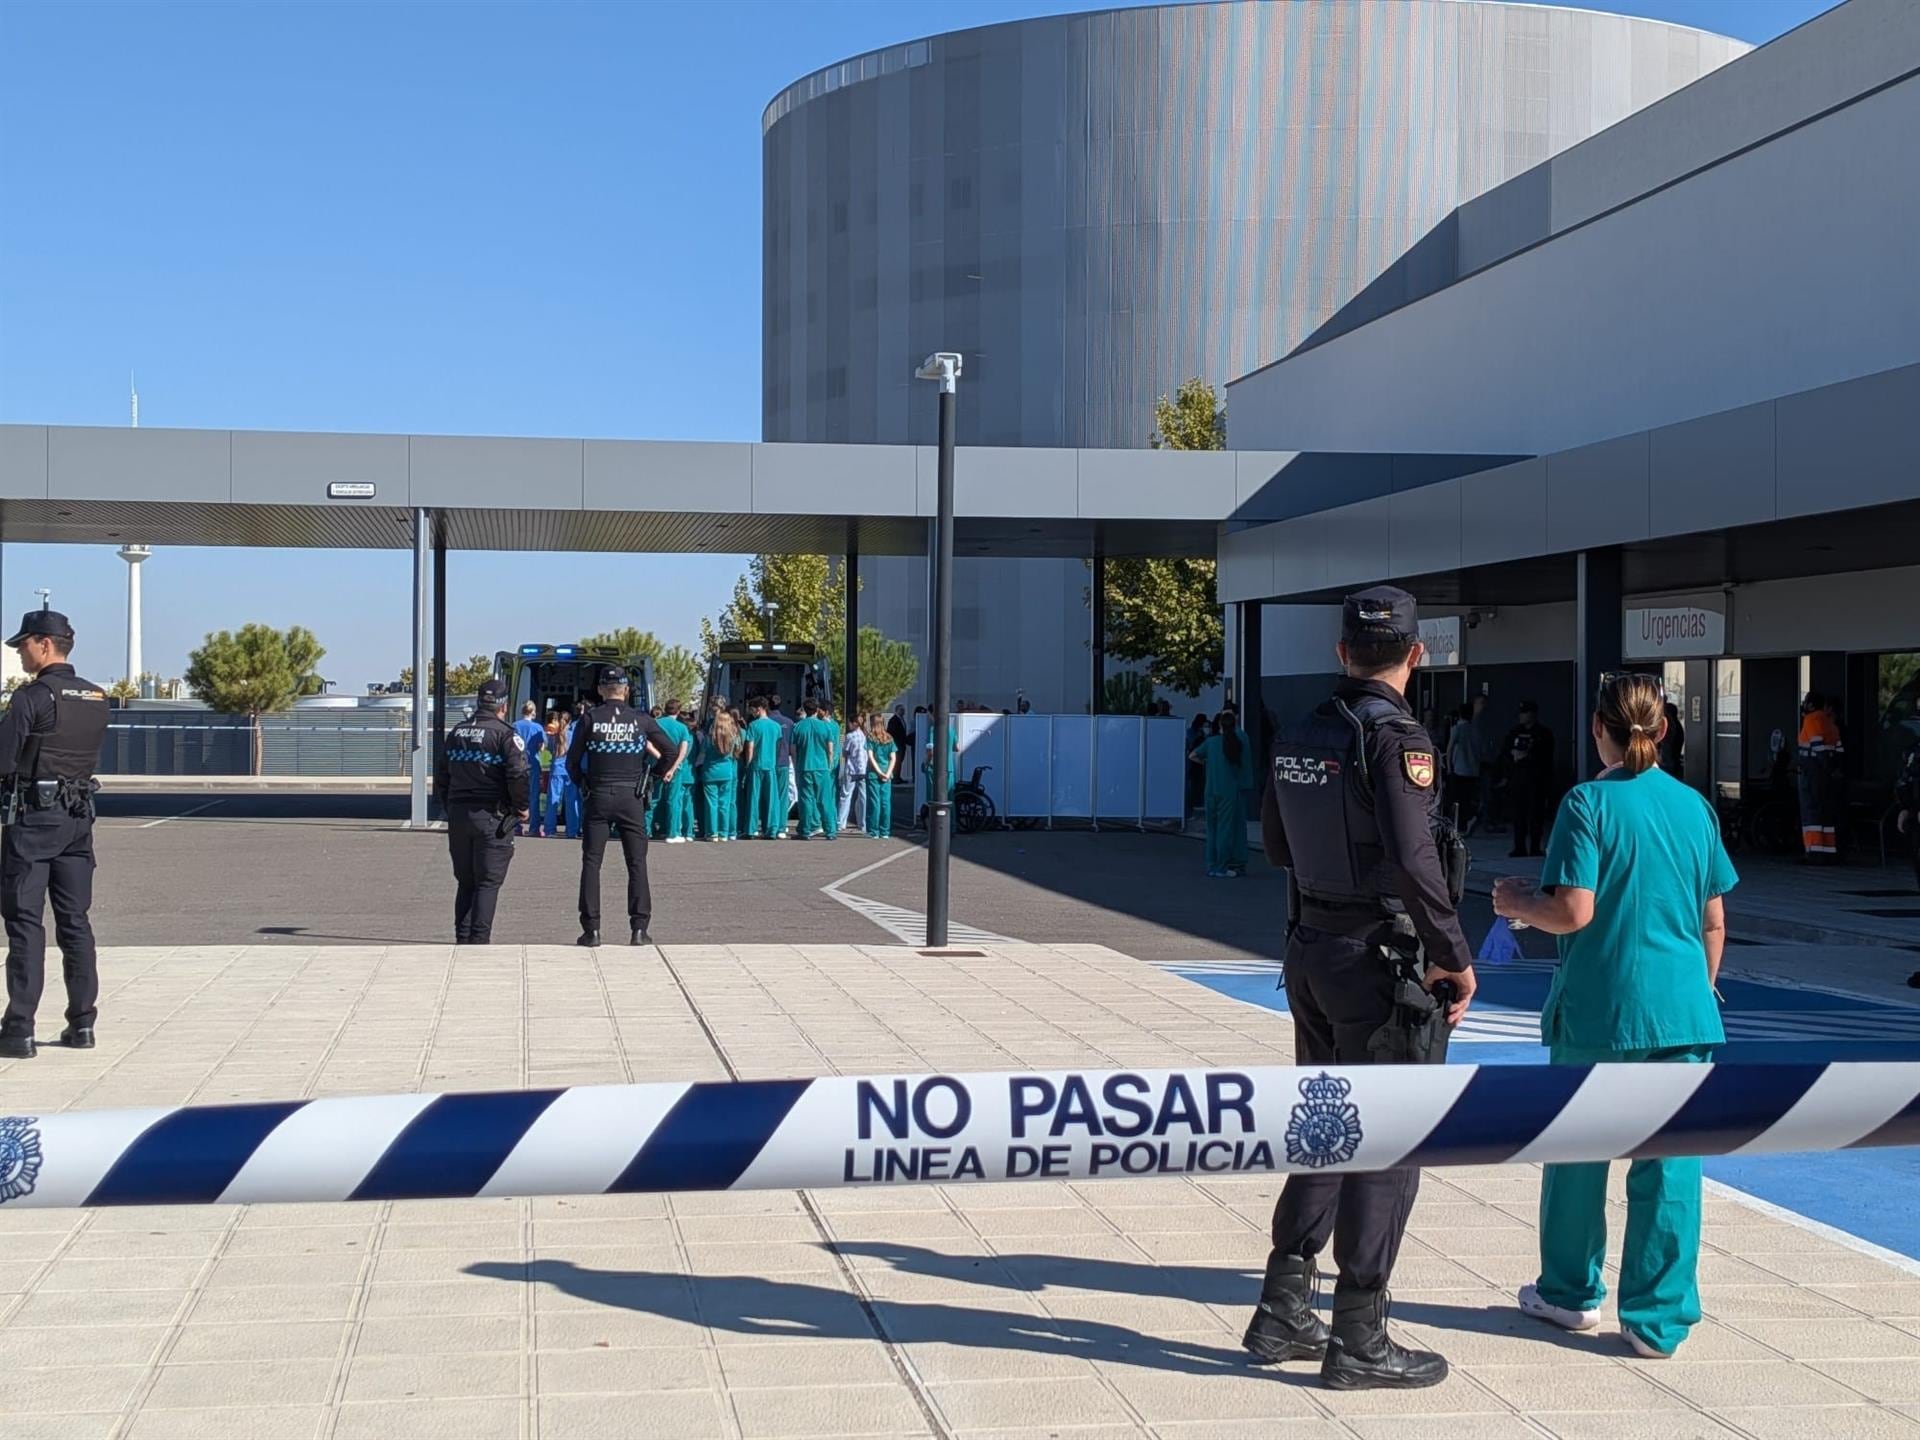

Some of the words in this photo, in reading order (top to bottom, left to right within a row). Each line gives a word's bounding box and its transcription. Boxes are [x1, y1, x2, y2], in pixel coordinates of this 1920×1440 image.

[1641, 607, 1706, 647] Urgencias
[1425, 631, 1455, 654] lancias
[454, 727, 486, 738] POLICIA
[592, 722, 635, 733] POLICIA
[605, 732, 635, 742] LOCAL
[857, 1074, 972, 1140] NO
[1008, 1071, 1256, 1139] PASAR
[843, 1145, 987, 1183] LINEA
[1005, 1143, 1072, 1178] DE
[1088, 1139, 1276, 1176] POLICIA
